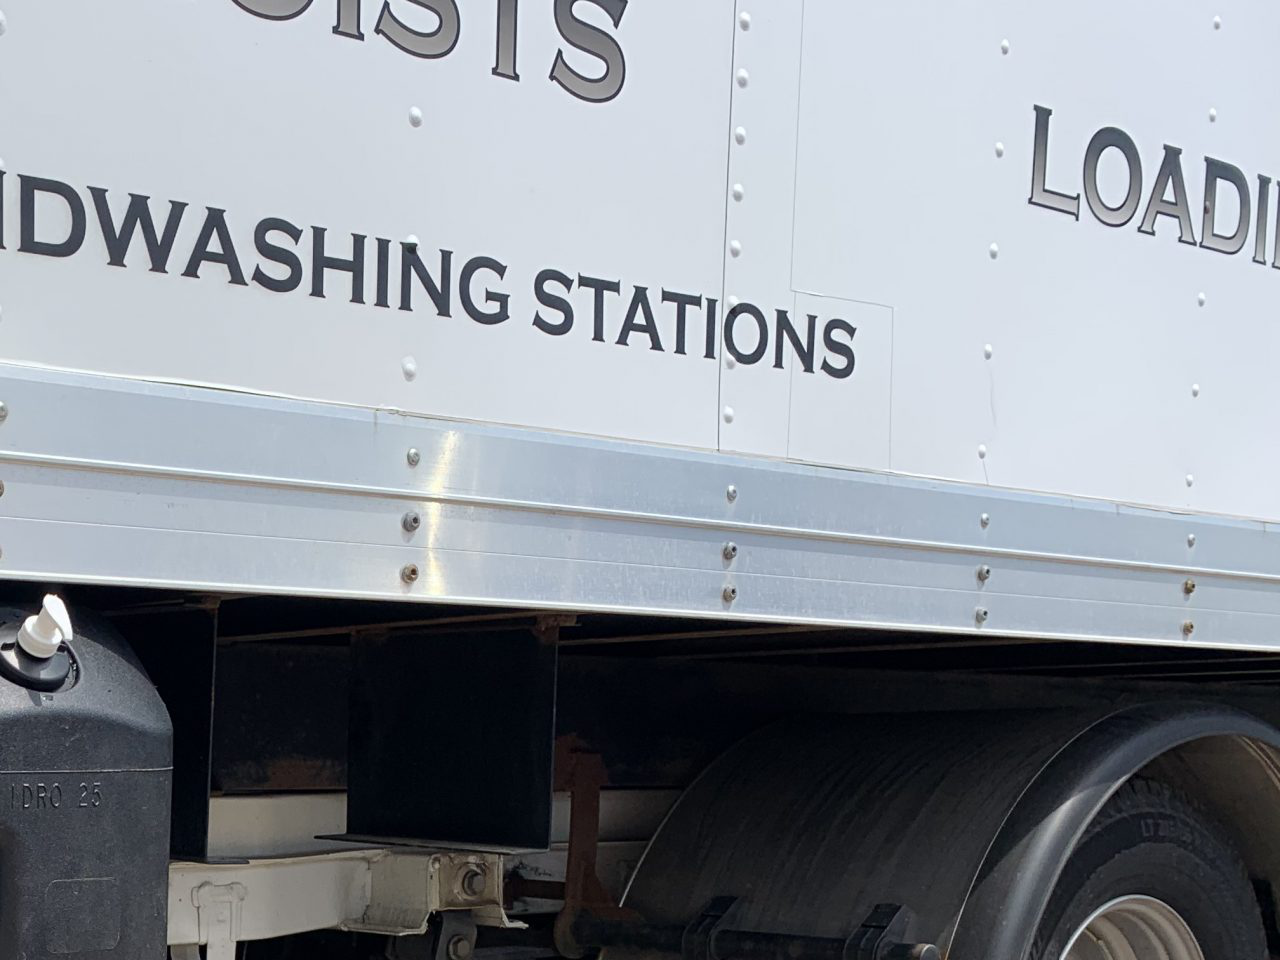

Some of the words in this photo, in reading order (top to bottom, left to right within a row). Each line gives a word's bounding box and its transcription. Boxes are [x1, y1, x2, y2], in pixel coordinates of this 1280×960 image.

[231, 0, 628, 103] STS
[1028, 104, 1280, 270] LOADI
[531, 268, 858, 379] STATIONS
[11, 782, 61, 809] IDRO
[80, 782, 101, 808] 25
